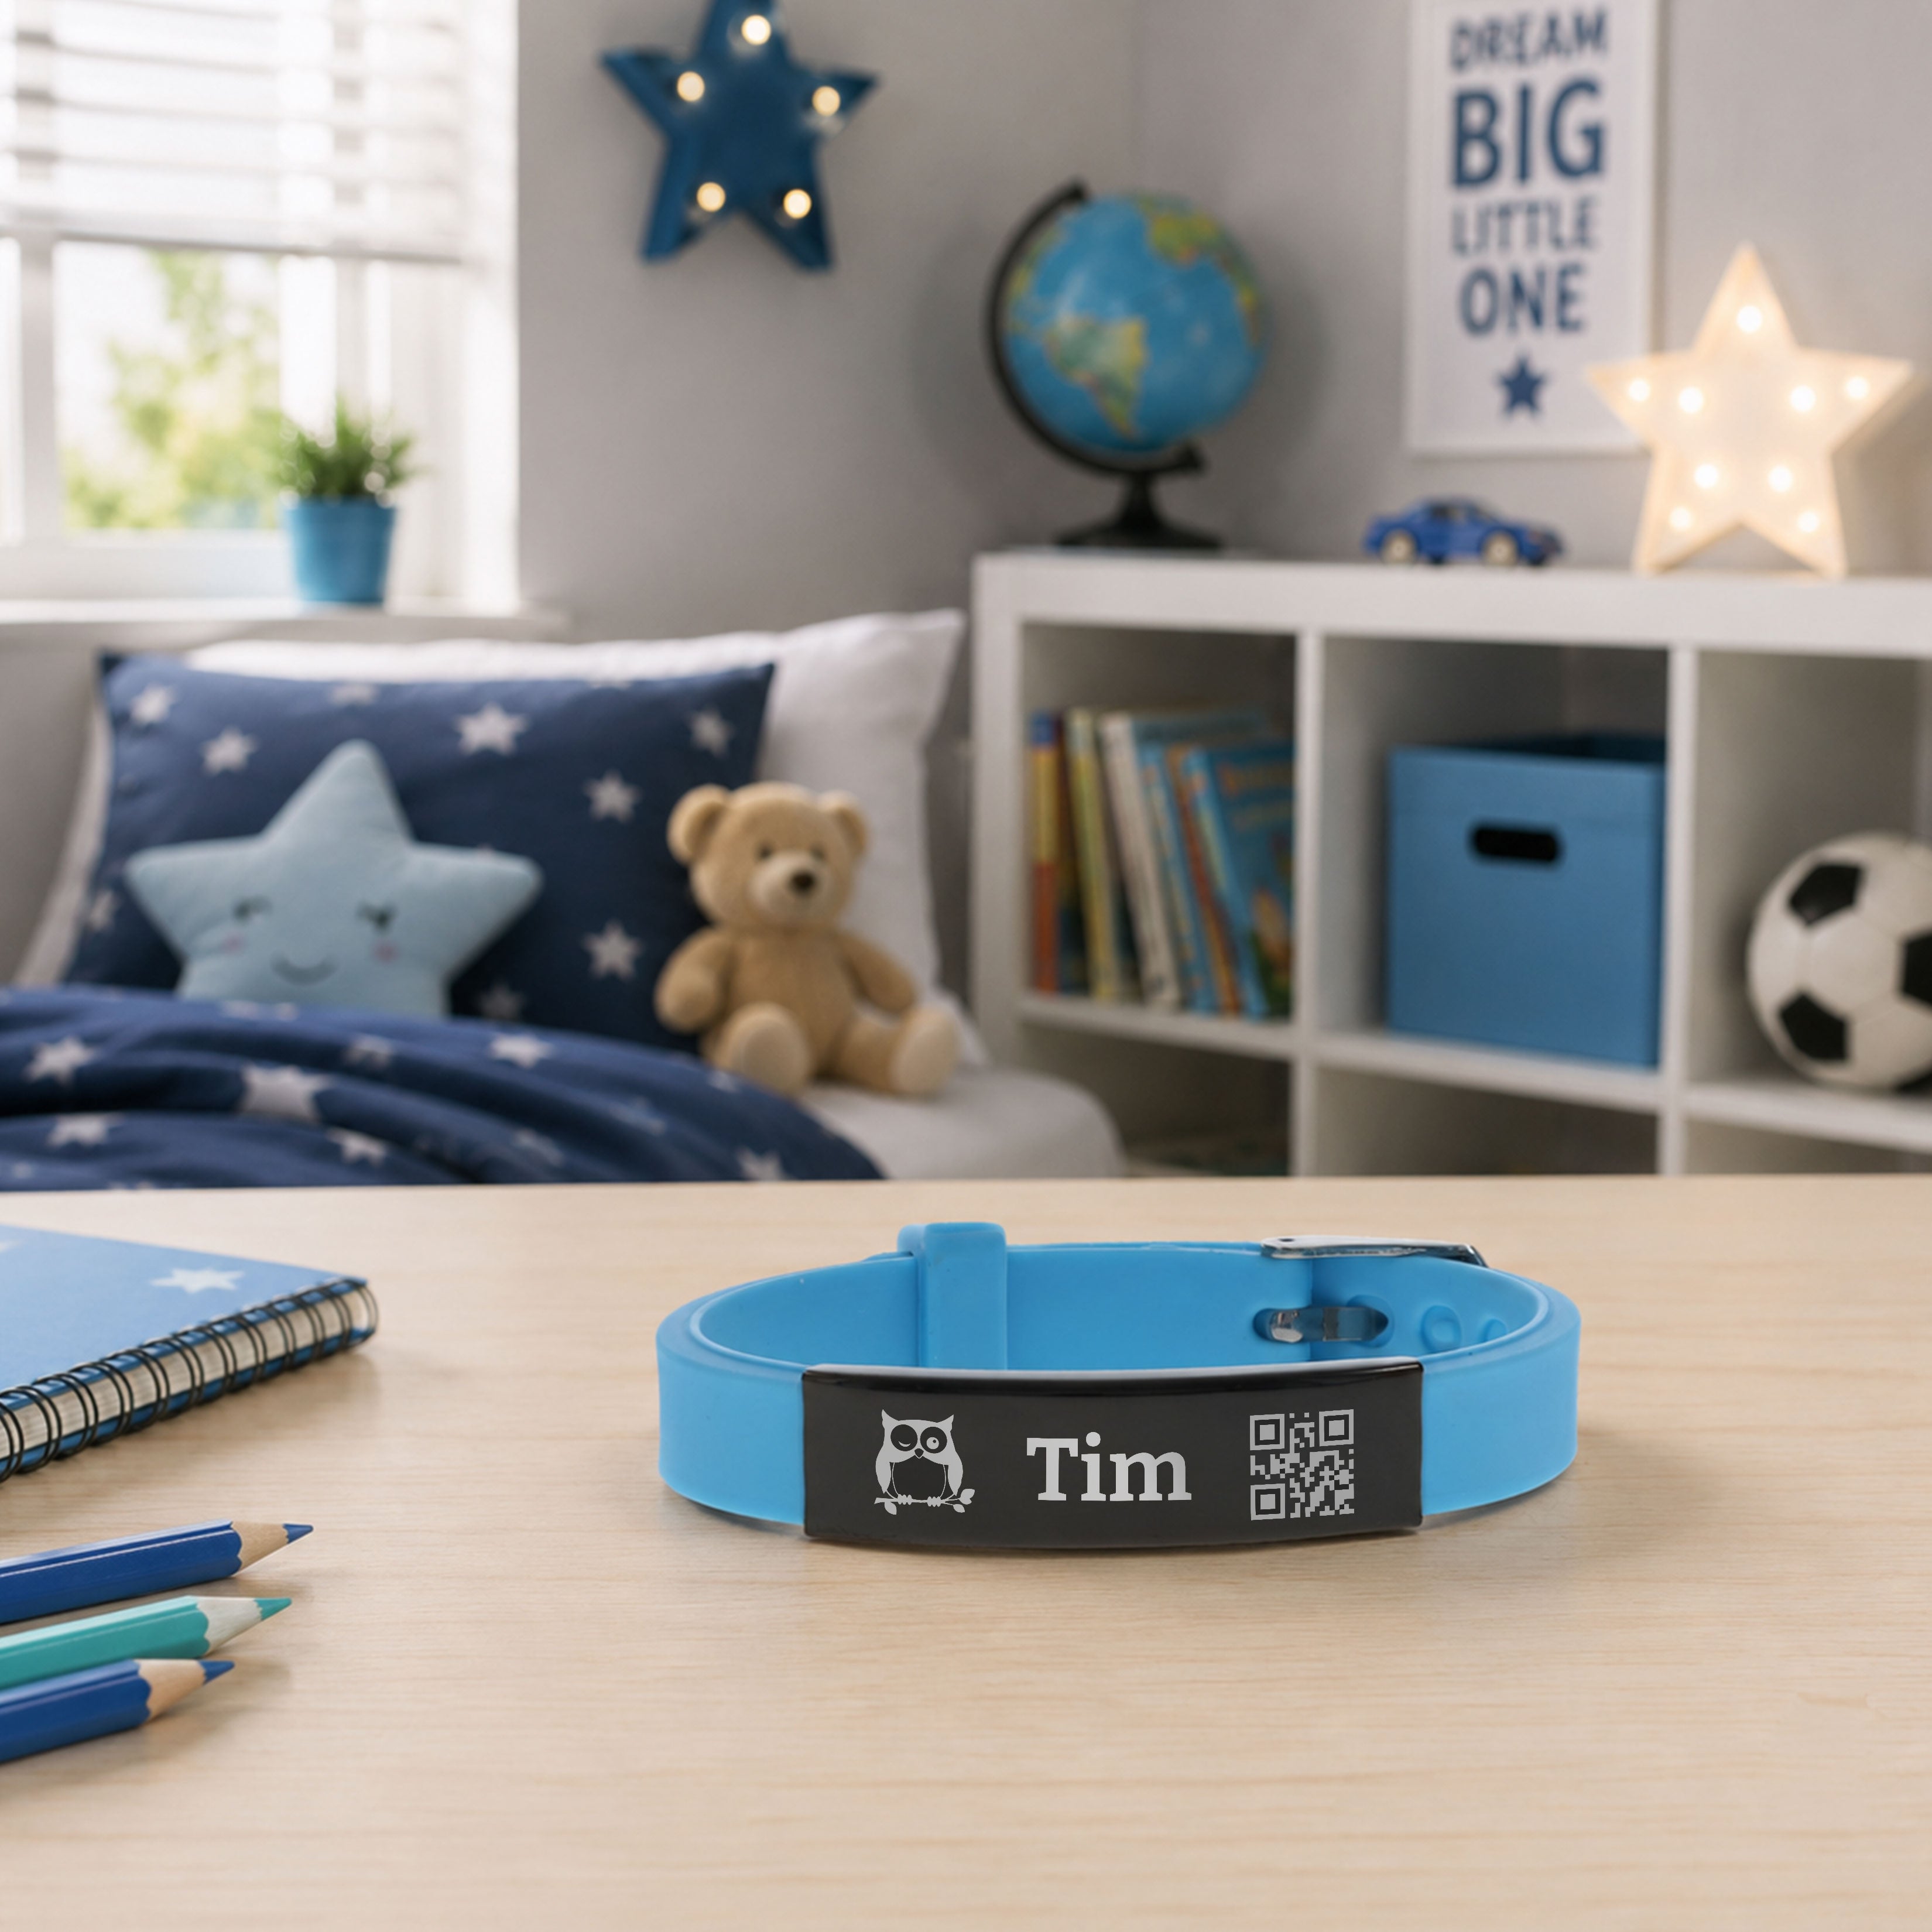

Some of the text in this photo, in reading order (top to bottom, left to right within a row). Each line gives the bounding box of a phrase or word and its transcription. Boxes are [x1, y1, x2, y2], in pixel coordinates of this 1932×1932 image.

[1451, 12, 1608, 71] DREAM
[1452, 77, 1605, 190] BIG
[1452, 197, 1597, 256] LITTLE
[1460, 263, 1587, 336] ONE
[1026, 1432, 1192, 1502] Tim
